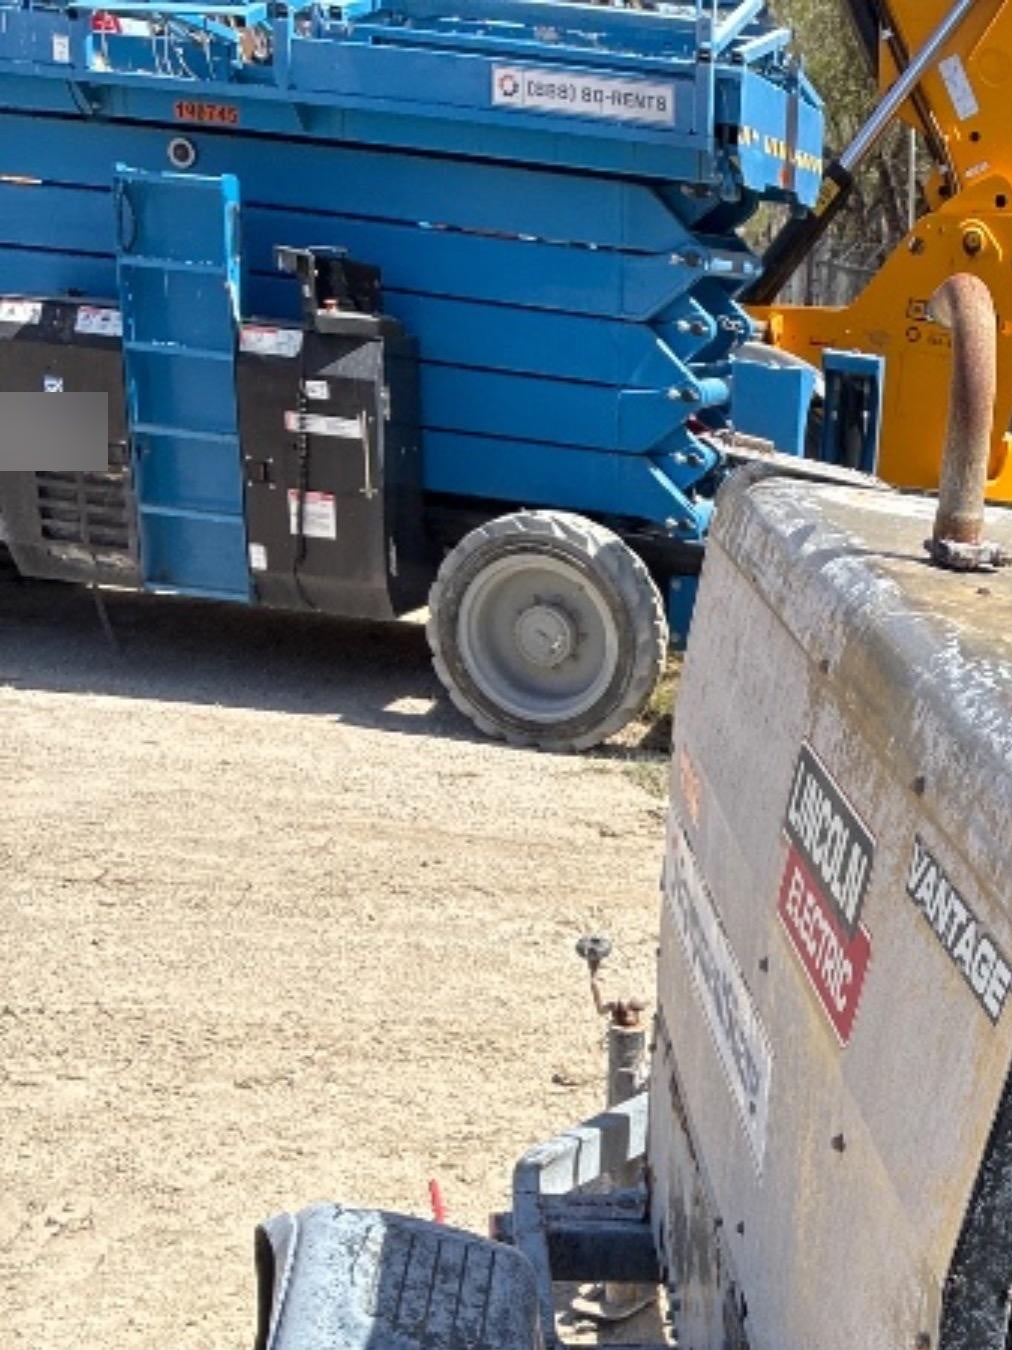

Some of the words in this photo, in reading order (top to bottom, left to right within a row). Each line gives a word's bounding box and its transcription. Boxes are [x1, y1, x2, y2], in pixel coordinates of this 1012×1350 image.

[788, 760, 868, 926] LINCOLN
[785, 866, 852, 1012] ELECTRIC
[909, 842, 1012, 1018] VANTAGE
